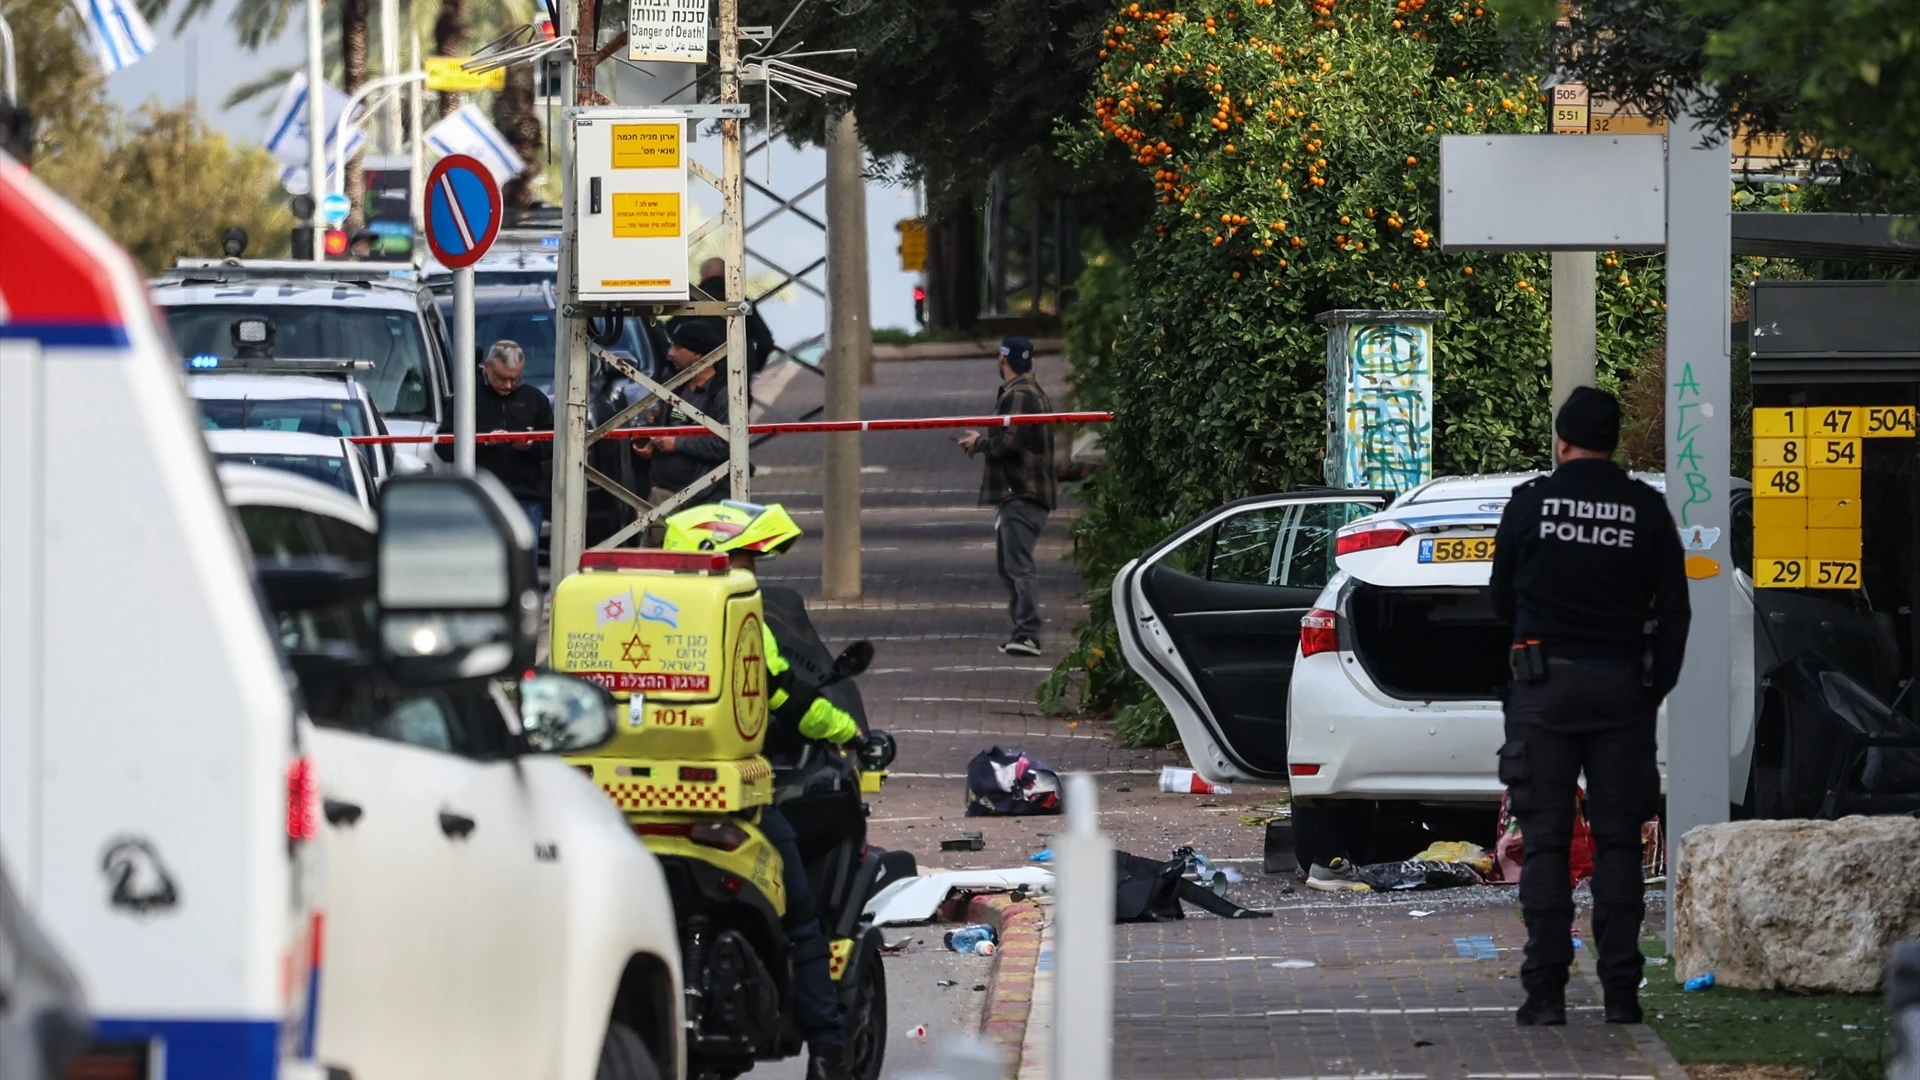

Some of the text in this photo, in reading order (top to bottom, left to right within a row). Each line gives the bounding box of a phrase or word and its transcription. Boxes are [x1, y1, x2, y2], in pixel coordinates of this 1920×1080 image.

[632, 8, 705, 23] סכנת מוות!
[631, 23, 705, 39] Danger of Death!
[1557, 89, 1576, 100] 505
[1558, 110, 1578, 121] 551
[1594, 119, 1609, 131] 32
[660, 134, 675, 142] ארון
[1784, 411, 1794, 433] 1
[1823, 409, 1853, 433] 47
[1868, 408, 1911, 432] 504
[1783, 440, 1797, 464] 8
[1825, 441, 1855, 464] 54
[1770, 470, 1801, 494] 48
[1541, 497, 1636, 524] משטרה
[1539, 520, 1635, 548] POLICE
[1422, 546, 1431, 556] IL
[1772, 561, 1801, 583] 29
[1818, 561, 1858, 585] 572
[567, 641, 598, 650] DAVID
[664, 635, 708, 648] מגן דוד
[567, 651, 598, 660] ADOM
[676, 648, 707, 659] אדום
[566, 660, 614, 669] IN ISRAEL
[659, 658, 706, 671] בישראל
[620, 673, 667, 688] ההצלה
[671, 676, 706, 690] ארגון
[653, 709, 687, 726] 101
